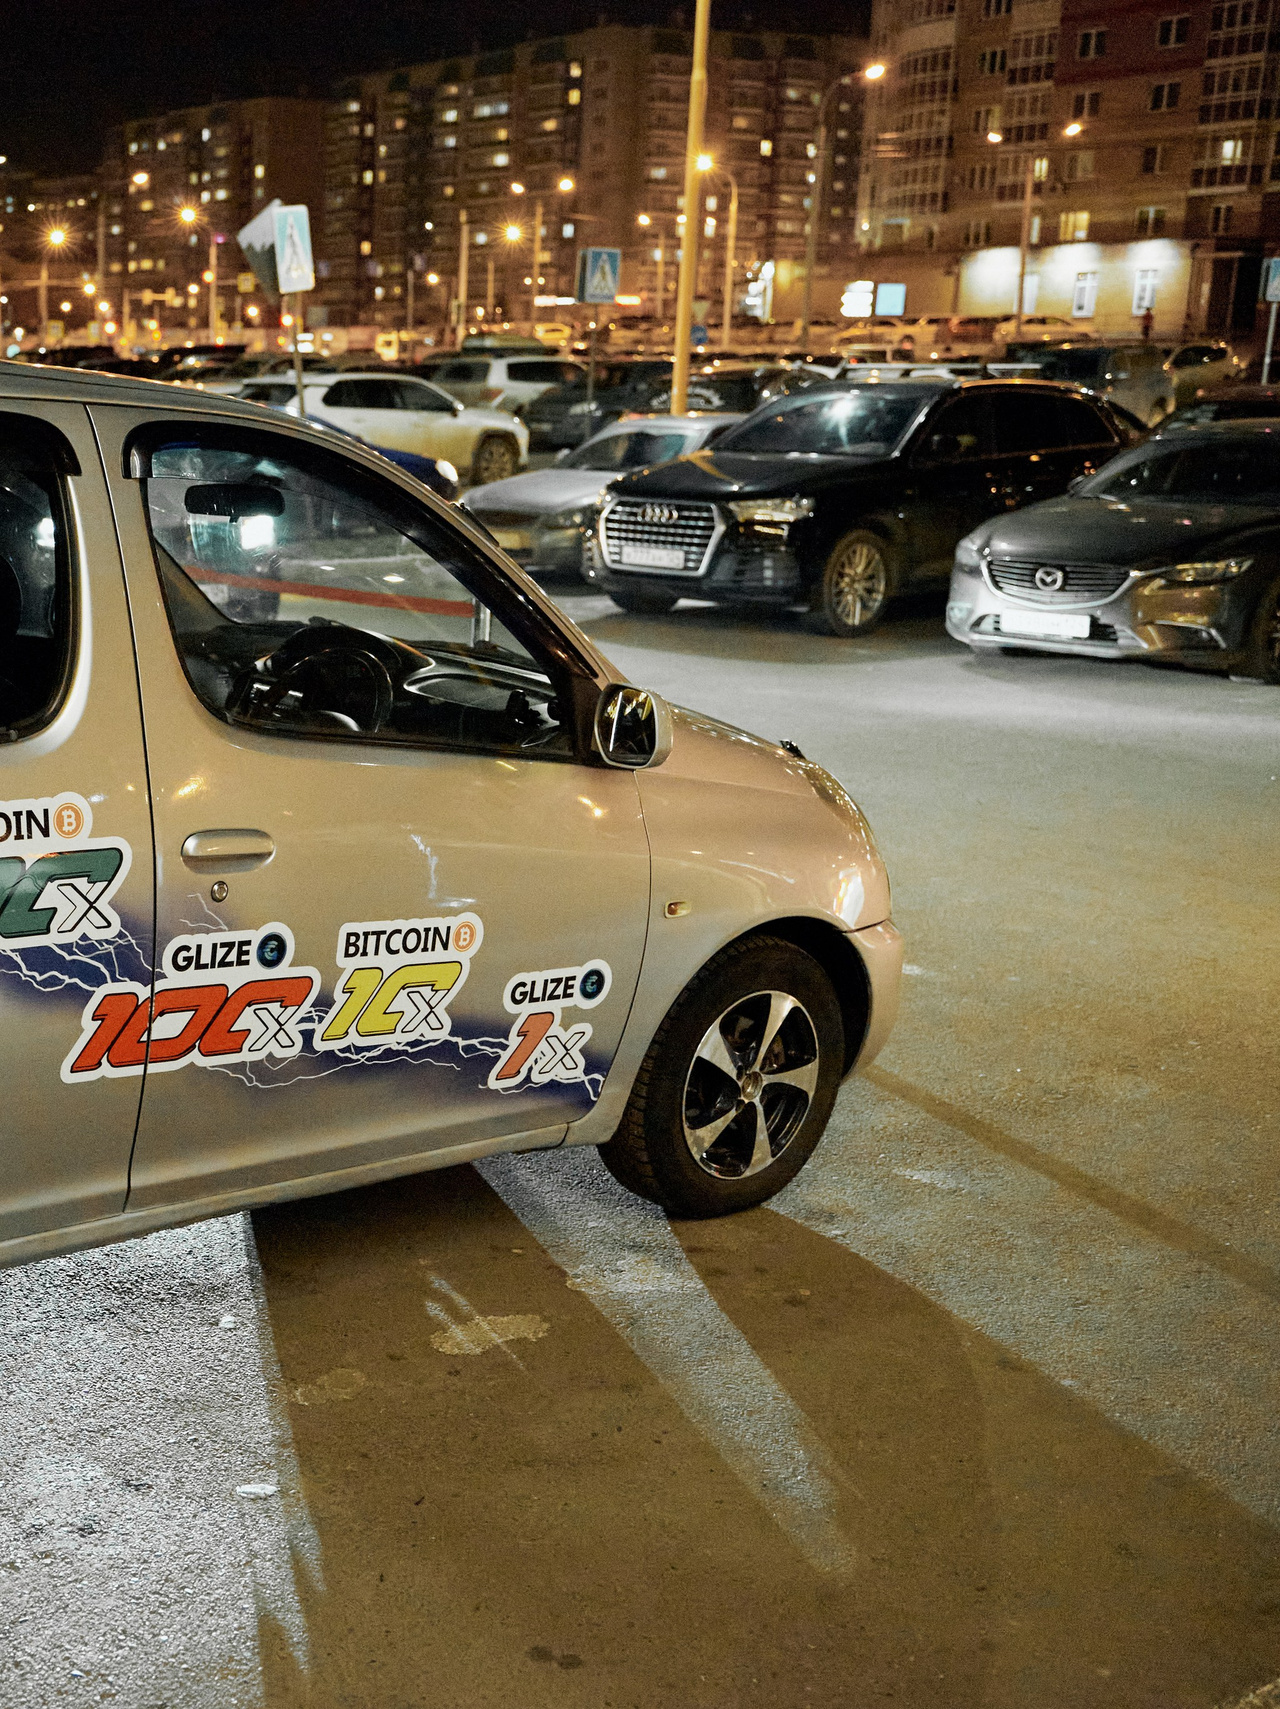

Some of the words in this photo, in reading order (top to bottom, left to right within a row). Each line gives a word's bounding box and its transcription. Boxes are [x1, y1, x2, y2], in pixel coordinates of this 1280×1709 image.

[171, 939, 252, 972] GLIZE
[343, 925, 452, 958] BITCOIN
[509, 975, 577, 1006] GLIZE
